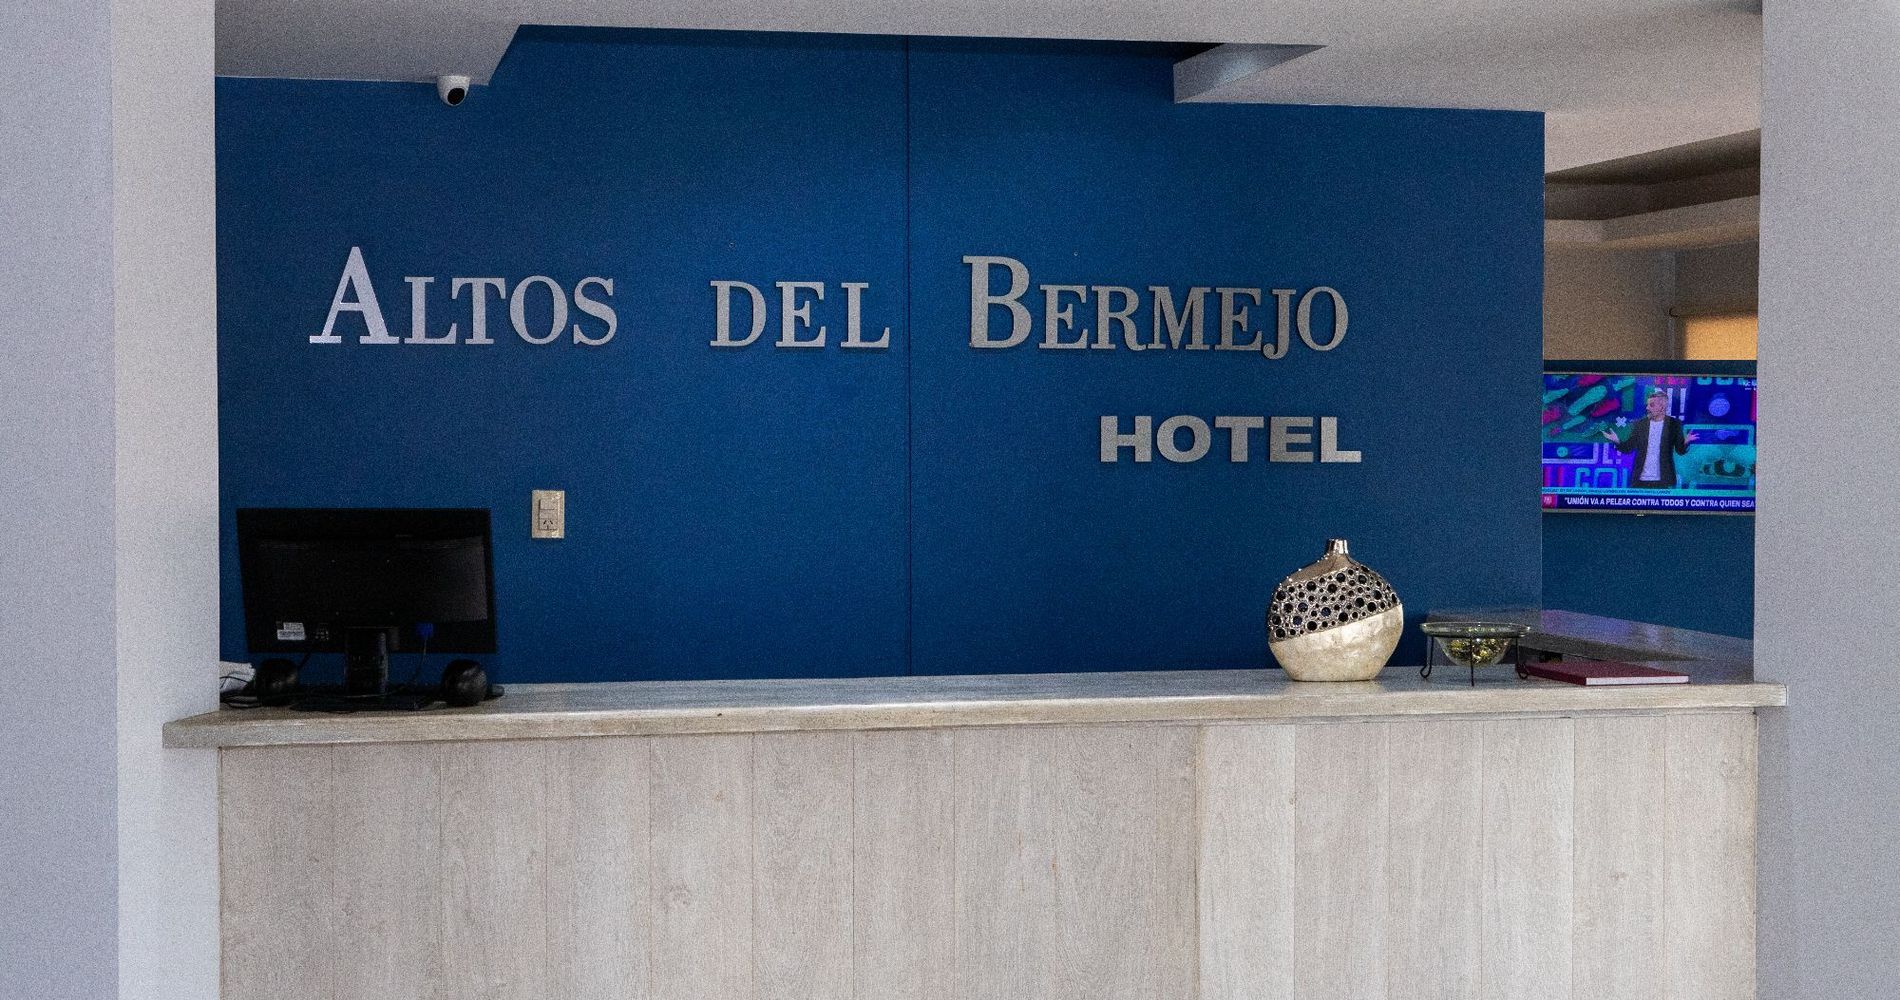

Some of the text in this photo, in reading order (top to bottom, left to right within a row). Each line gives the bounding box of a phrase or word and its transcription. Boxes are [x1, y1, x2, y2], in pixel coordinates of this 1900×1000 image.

[309, 246, 1349, 360] ALTOS DEL BERMEJO
[1100, 414, 1362, 463] HOTEL
[1590, 497, 1599, 505] VA
[1600, 497, 1605, 505] A
[1606, 497, 1631, 505] PELEAR
[1631, 498, 1660, 506] CONTRA
[1661, 499, 1684, 507] TODOS
[1684, 499, 1690, 507] Y
[1690, 499, 1719, 507] CONTRA
[1719, 500, 1741, 508] QUIEN
[1741, 500, 1755, 508] SEA
